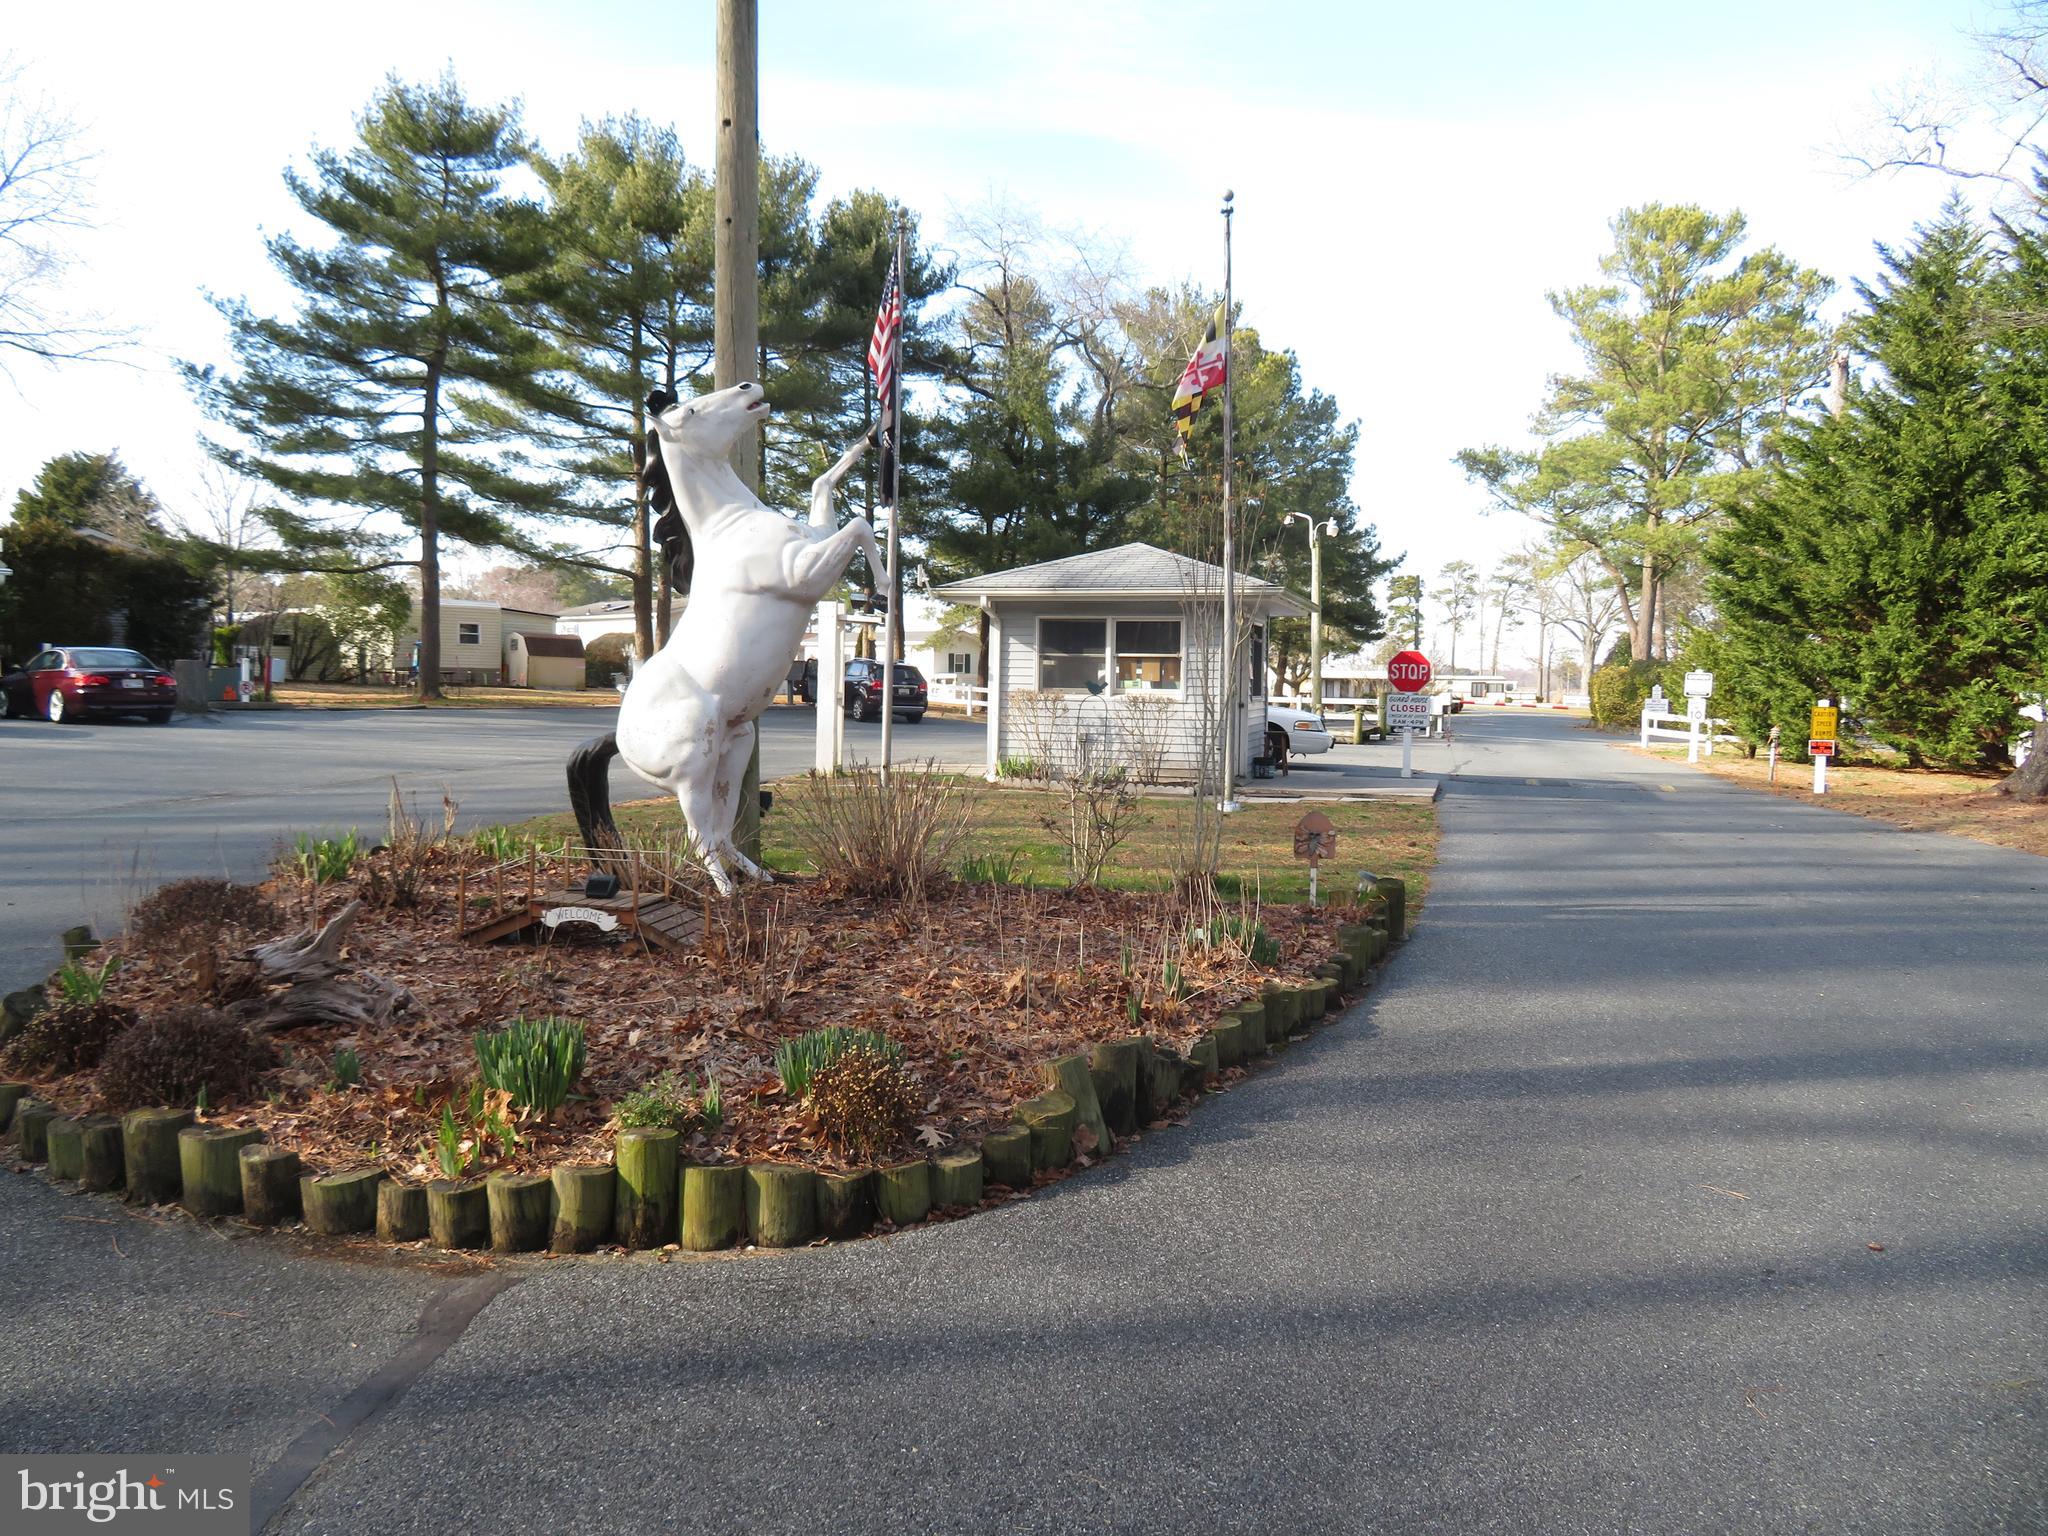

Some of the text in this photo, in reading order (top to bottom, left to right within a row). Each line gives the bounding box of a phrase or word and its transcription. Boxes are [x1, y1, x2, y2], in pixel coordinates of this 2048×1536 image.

[1391, 663, 1428, 680] STOP
[1391, 704, 1427, 713] CLOSED
[556, 909, 604, 922] WELCOME
